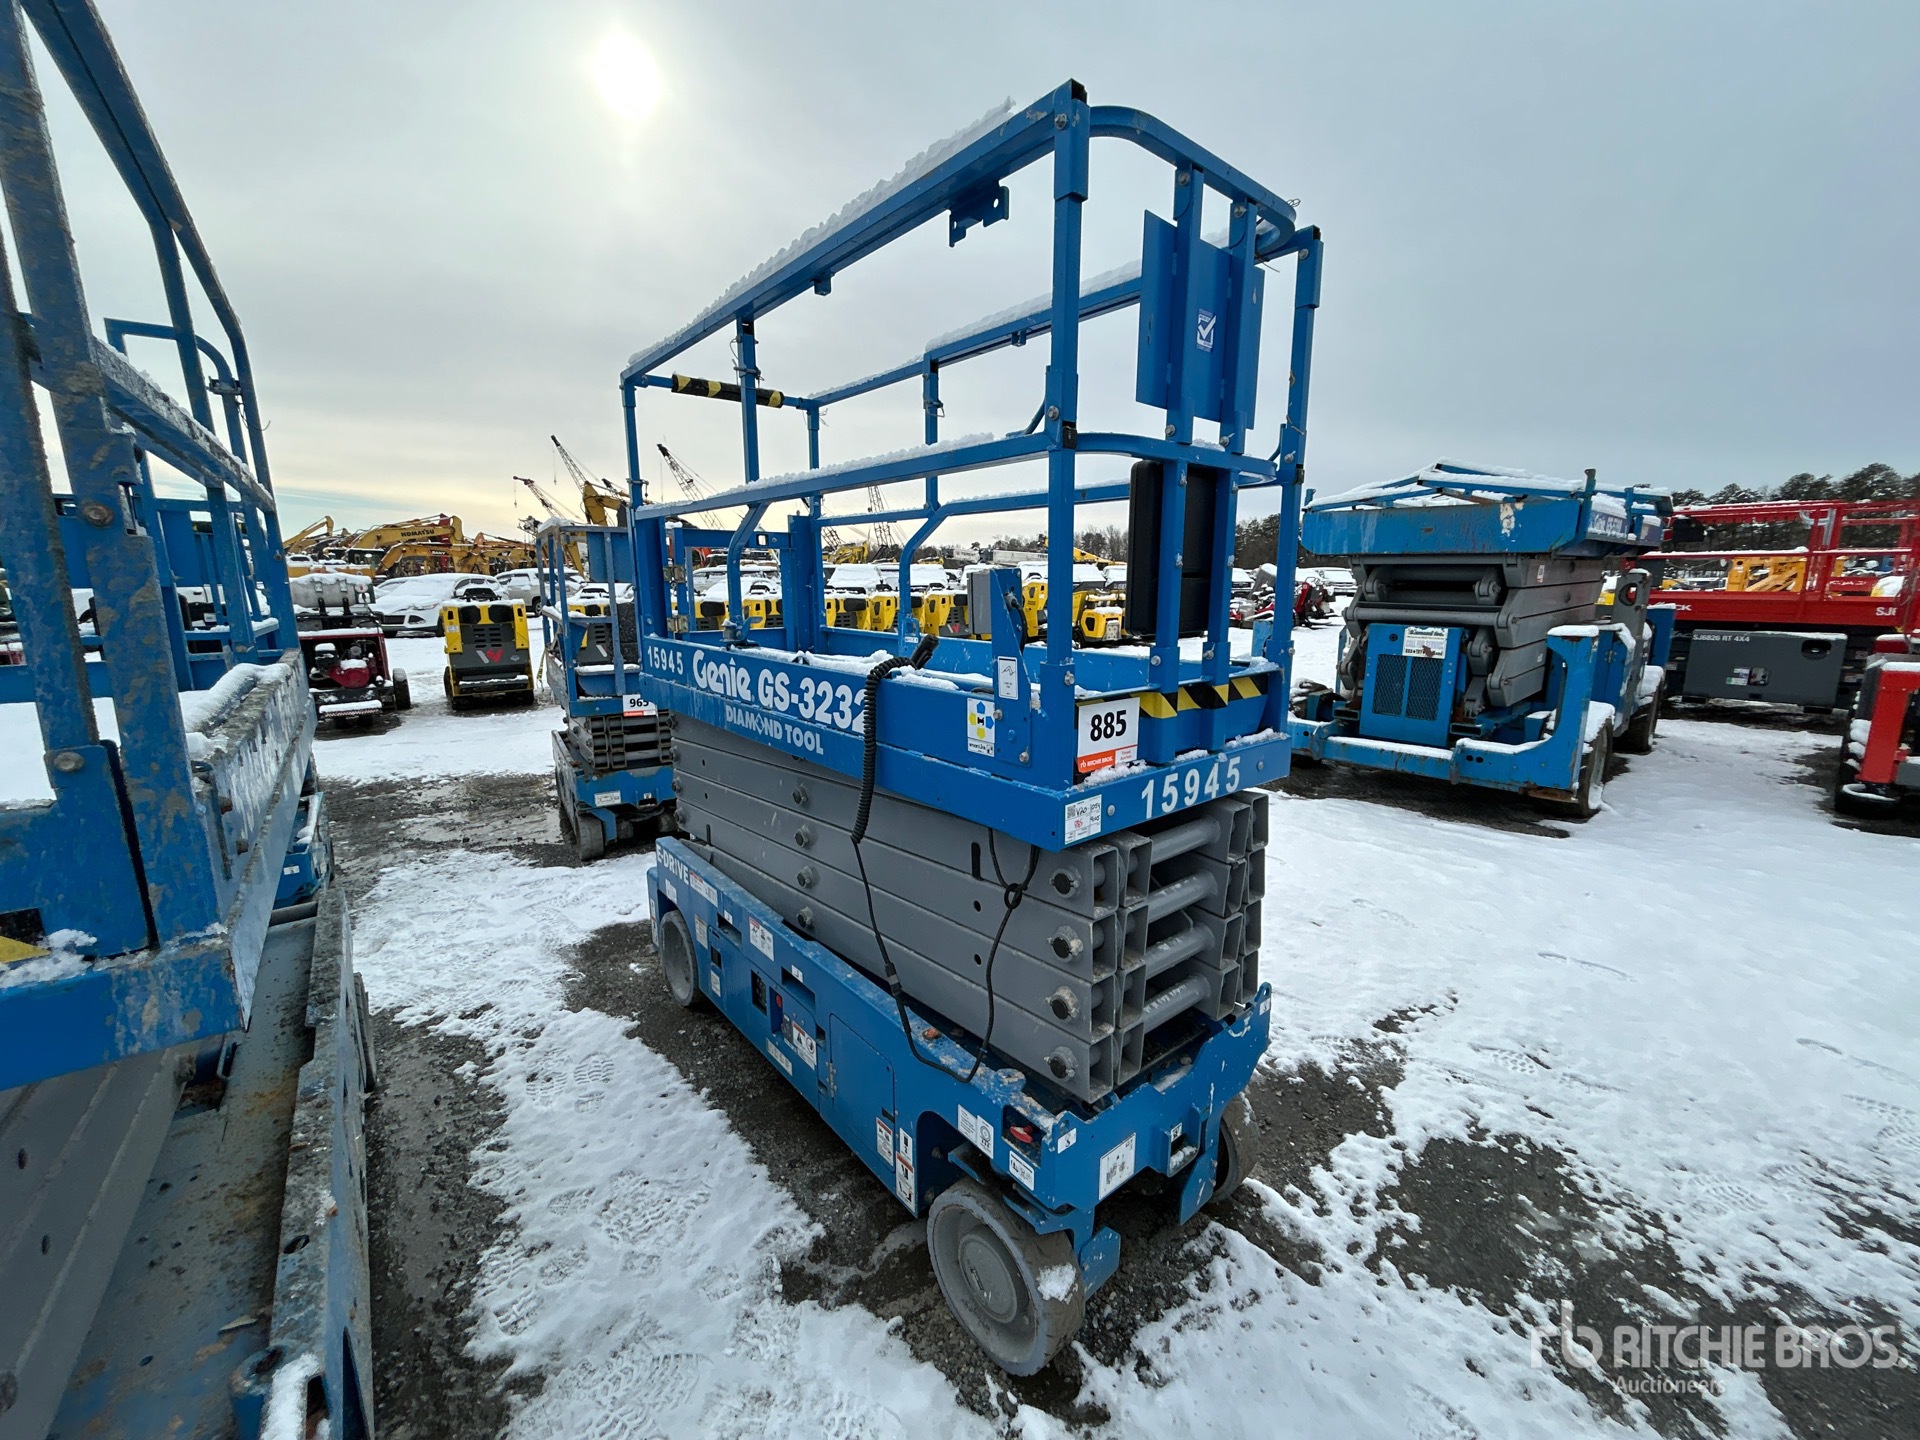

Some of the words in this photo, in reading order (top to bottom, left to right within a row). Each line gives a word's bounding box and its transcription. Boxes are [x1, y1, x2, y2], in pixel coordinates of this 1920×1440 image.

[400, 529, 435, 537] KOMATSU
[648, 645, 684, 675] 15945
[692, 649, 752, 702] Genie
[757, 668, 865, 734] GS-3232
[725, 704, 783, 740] DIAMOND
[784, 723, 824, 755] TOOL
[1090, 709, 1127, 742] 885
[1141, 756, 1241, 820] 15945
[656, 844, 690, 886] E-DRIVE
